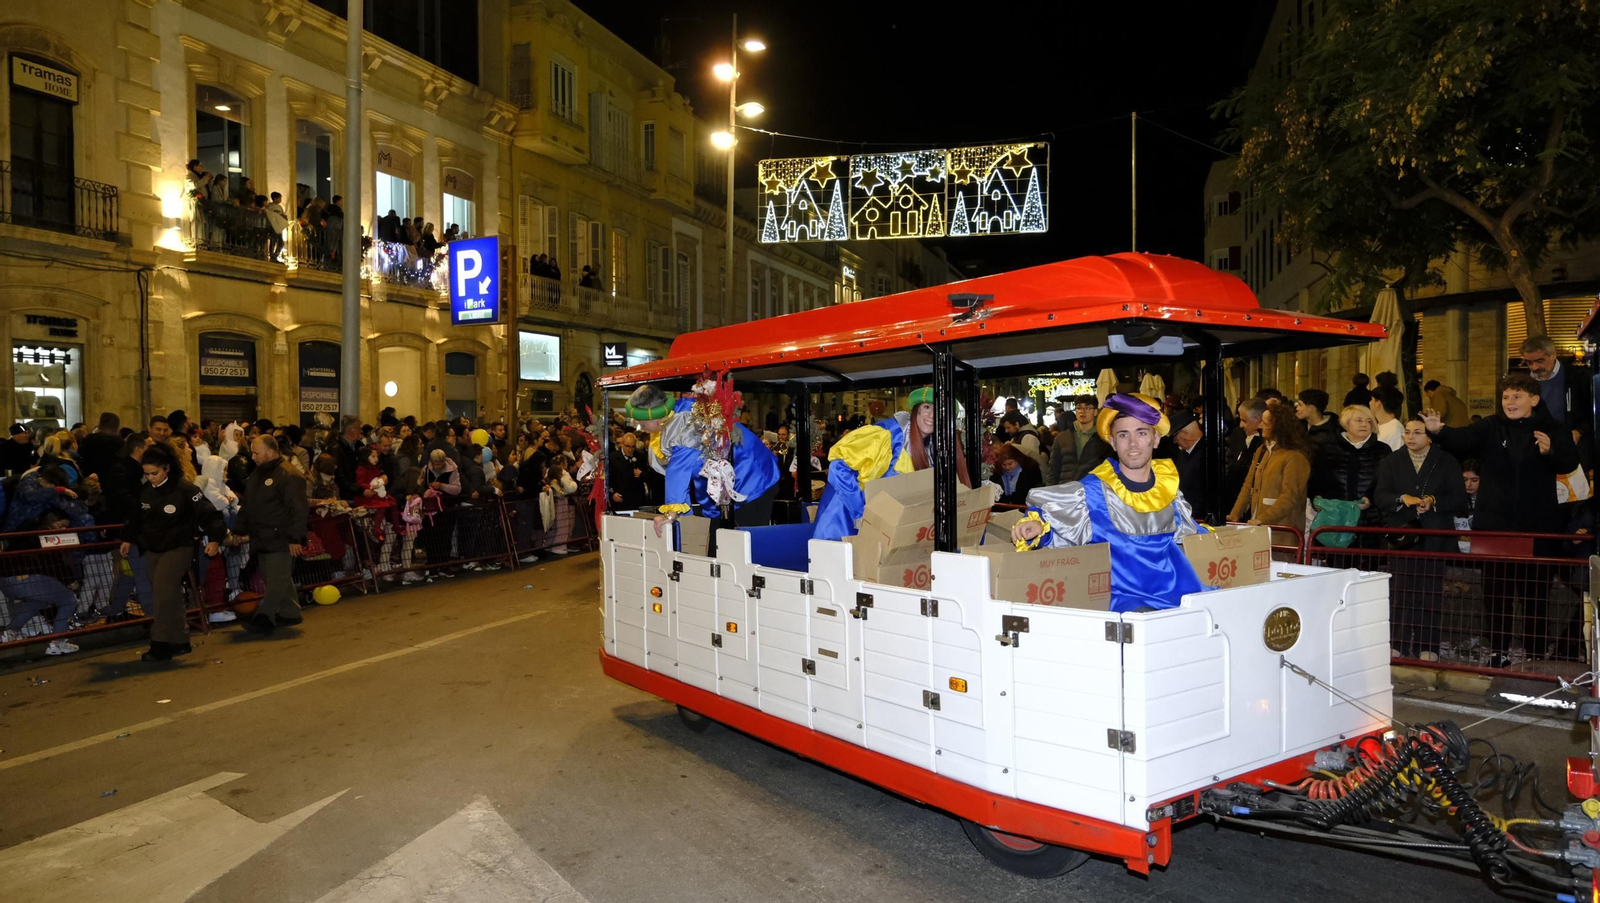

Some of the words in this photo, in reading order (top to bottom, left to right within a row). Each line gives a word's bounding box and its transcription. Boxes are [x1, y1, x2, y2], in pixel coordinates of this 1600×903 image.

[457, 249, 482, 297] P
[207, 359, 244, 367] DISPONIBLE
[204, 367, 219, 375] 950
[301, 391, 338, 400] DISPONIBLE
[301, 403, 315, 411] 950
[315, 403, 323, 411] 27
[1040, 560, 1055, 569] MUY
